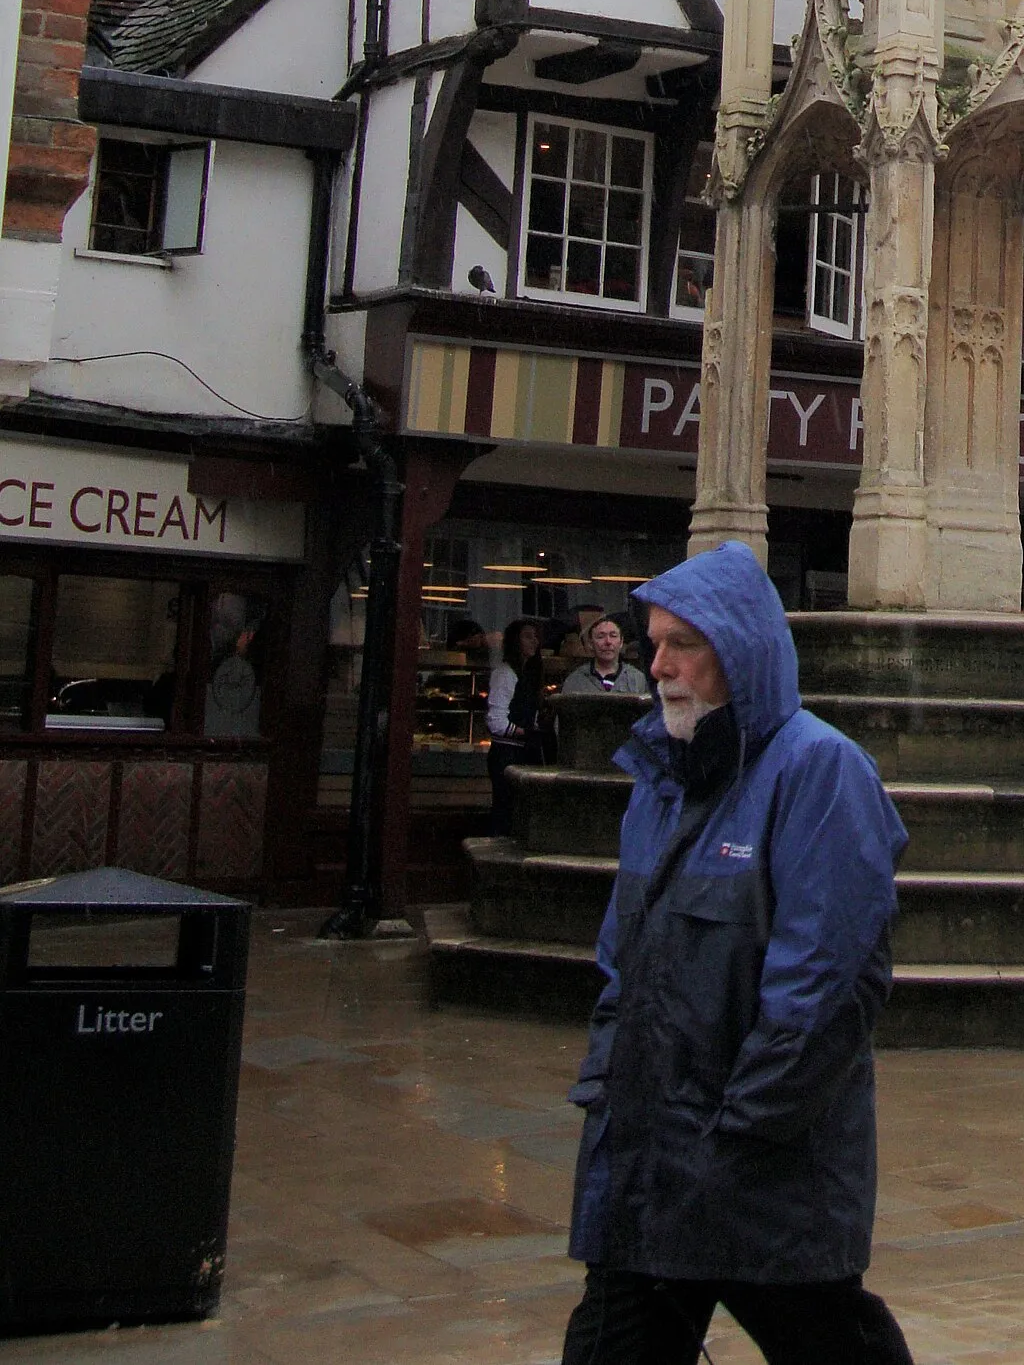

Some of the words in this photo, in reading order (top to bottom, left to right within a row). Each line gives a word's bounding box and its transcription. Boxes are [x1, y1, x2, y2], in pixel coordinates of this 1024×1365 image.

[641, 377, 826, 446] PATY
[70, 486, 227, 543] CREAM
[78, 1004, 164, 1033] Litter
